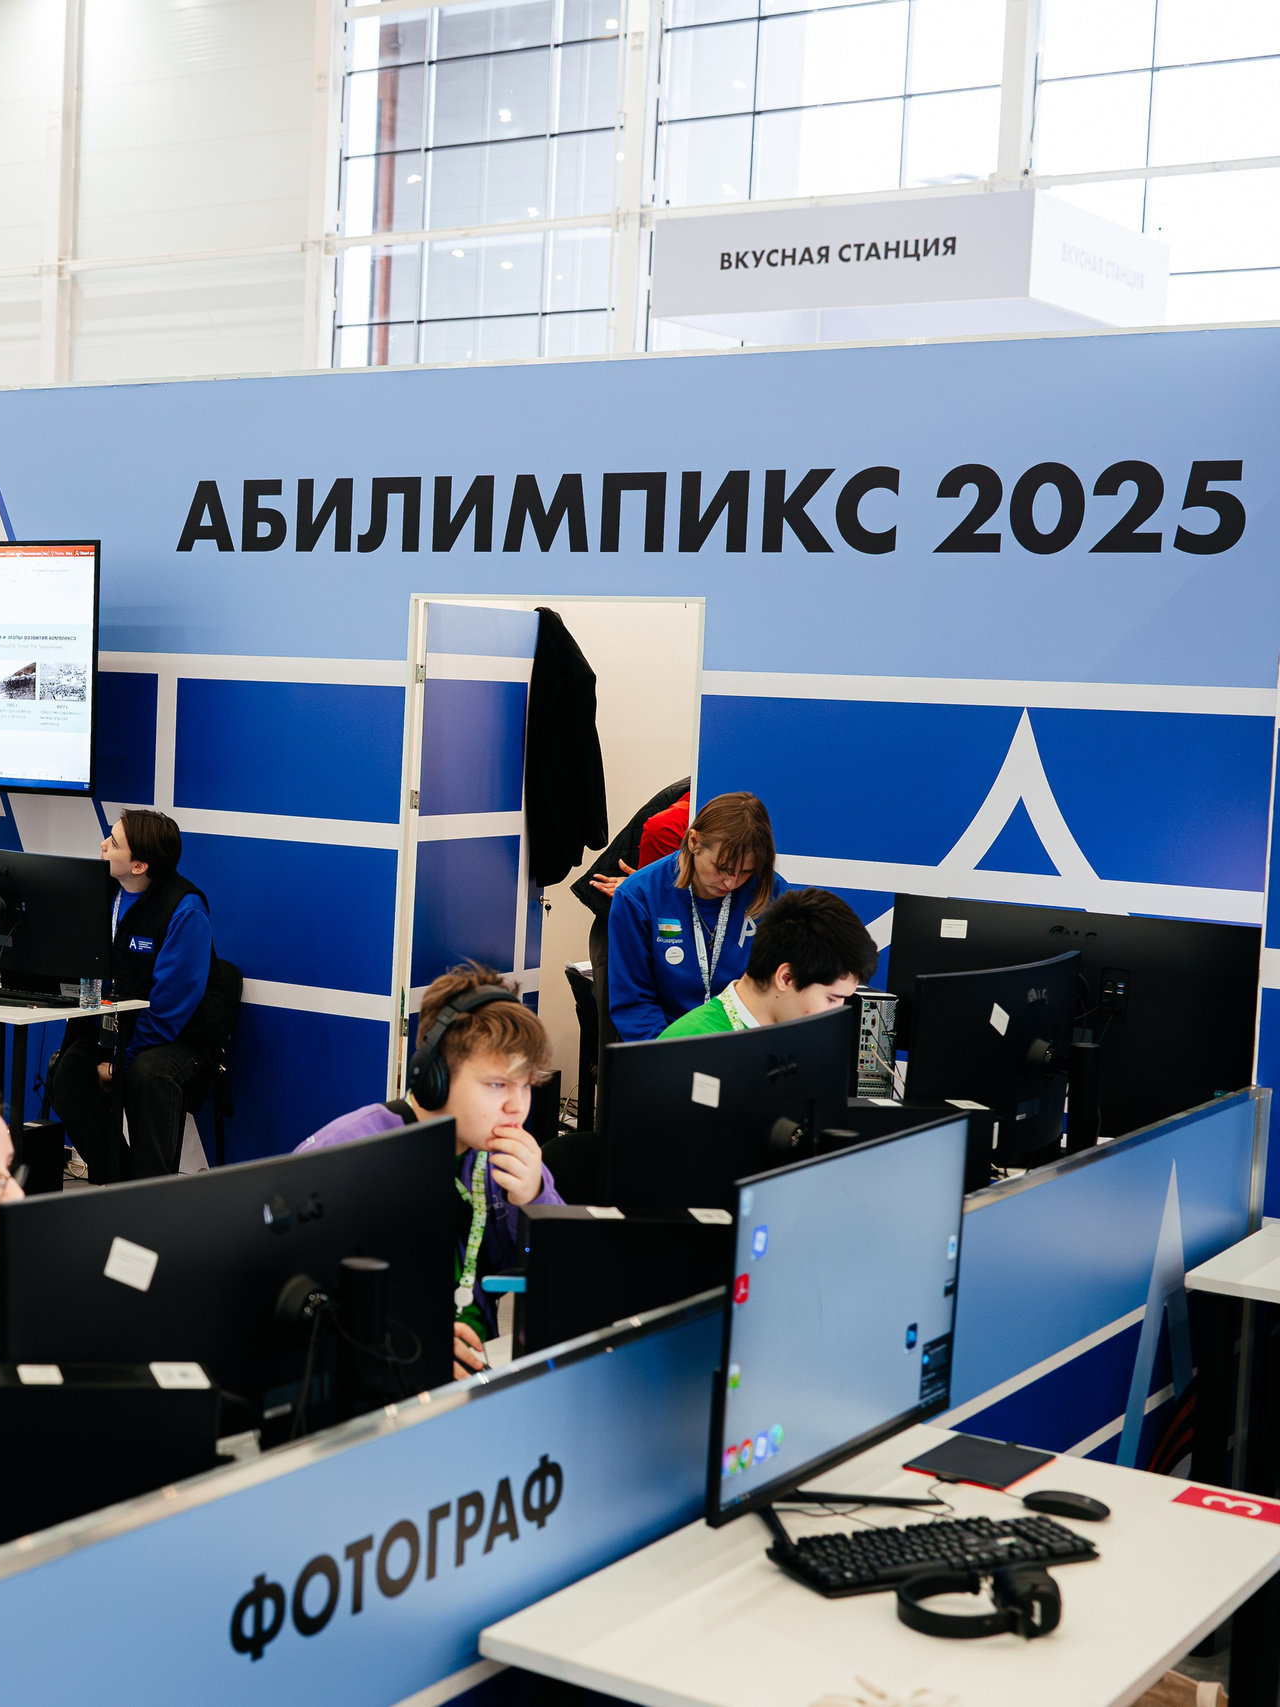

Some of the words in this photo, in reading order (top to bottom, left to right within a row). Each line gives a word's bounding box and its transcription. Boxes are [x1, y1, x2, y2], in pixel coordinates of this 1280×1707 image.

[719, 245, 830, 270] ВКУСНАЯ
[837, 236, 957, 262] СТАНЦИЯ
[176, 466, 900, 555] АБИЛИМПИКС
[932, 459, 1247, 556] 2025
[1202, 1495, 1263, 1516] 3
[230, 1453, 564, 1663] ФОТОГРАФ
